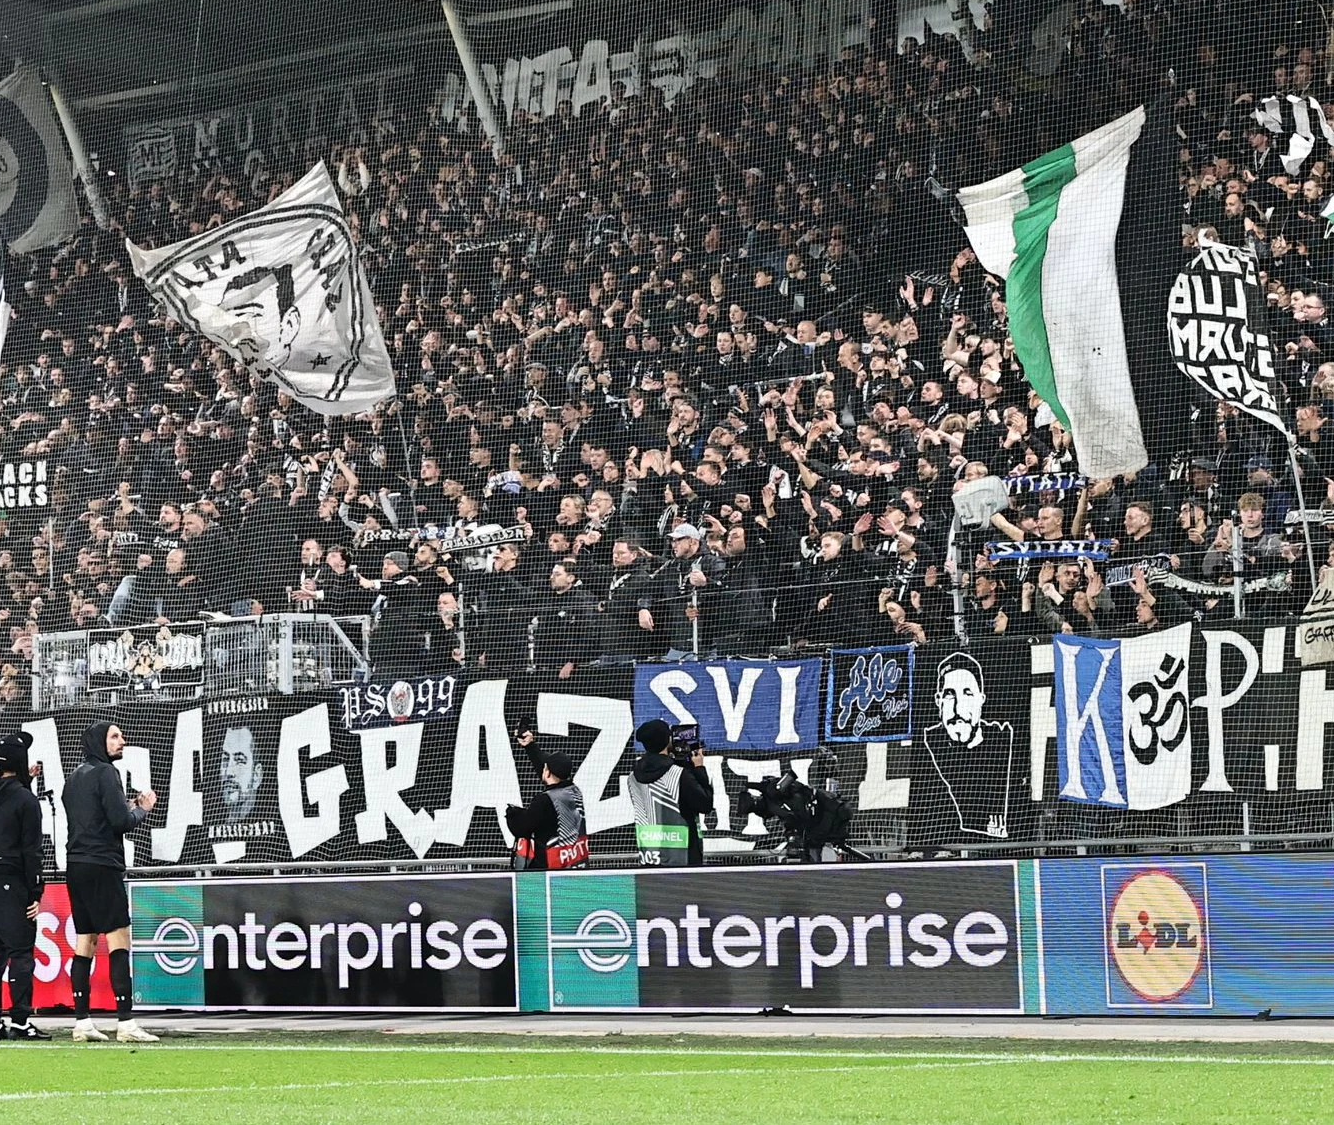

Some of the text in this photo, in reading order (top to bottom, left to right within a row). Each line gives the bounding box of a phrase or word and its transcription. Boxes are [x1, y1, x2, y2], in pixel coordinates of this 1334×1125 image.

[649, 663, 803, 745] SVI
[276, 679, 635, 859] GRAZ
[639, 831, 684, 843] CHANNEL
[152, 901, 508, 989] enterprise
[575, 893, 1008, 988] enterprise
